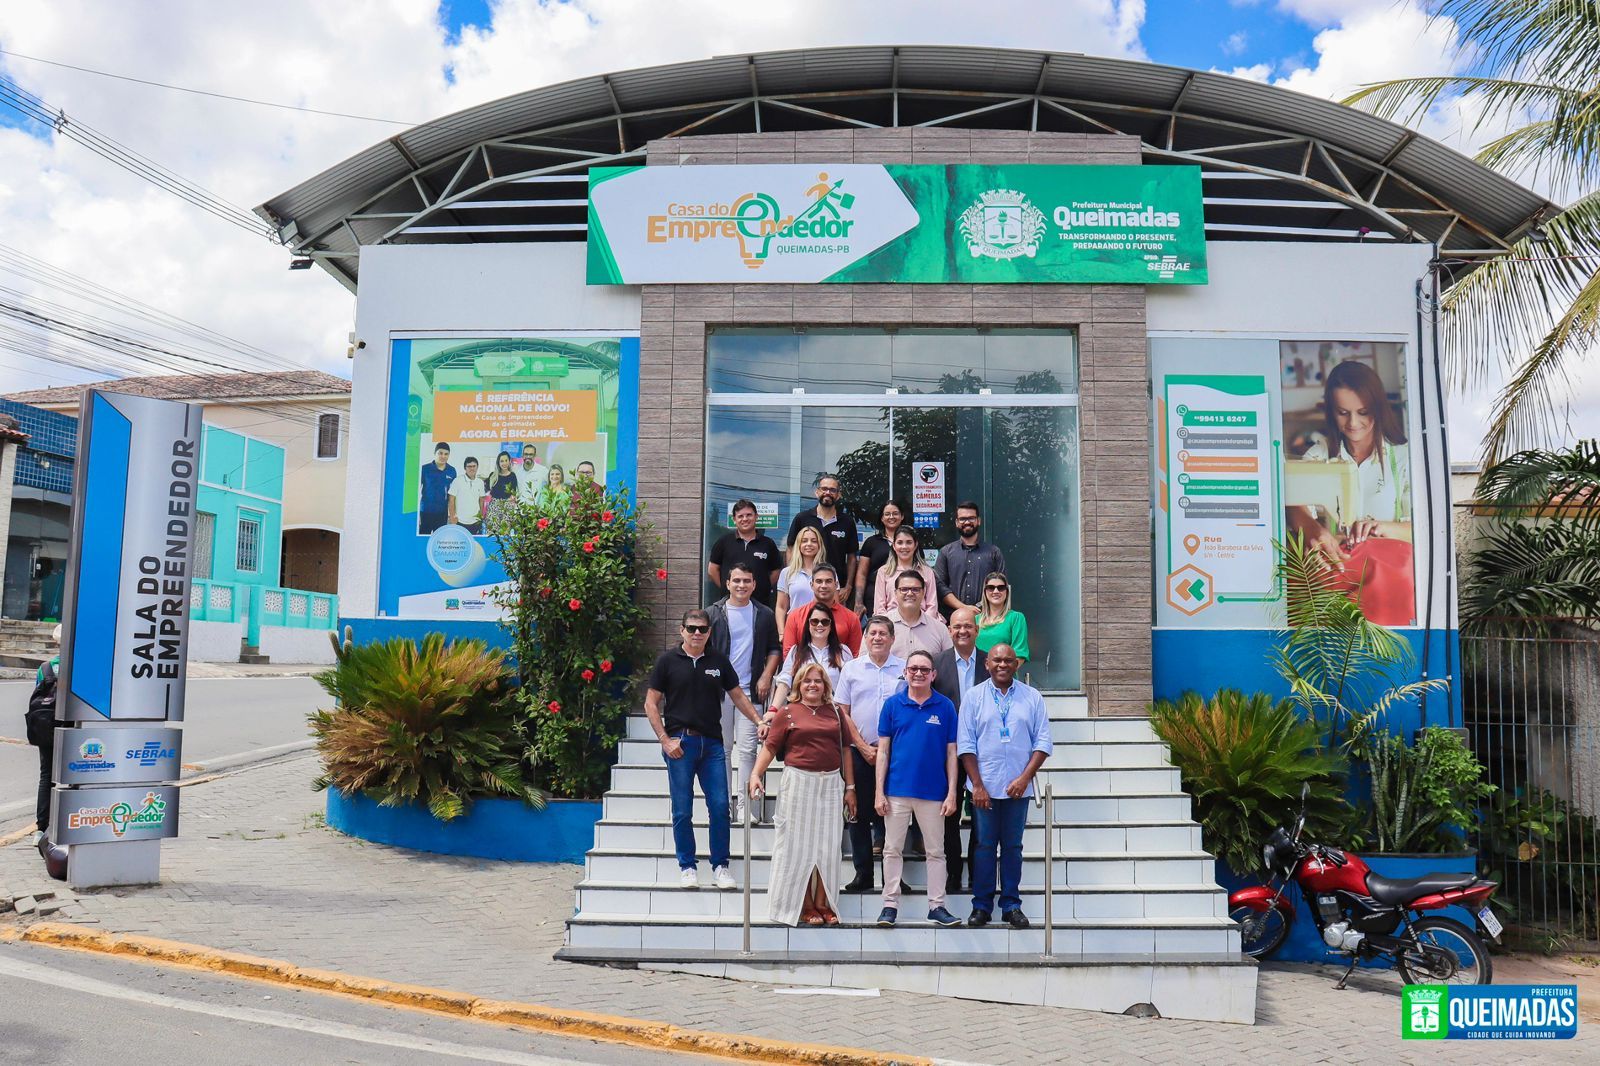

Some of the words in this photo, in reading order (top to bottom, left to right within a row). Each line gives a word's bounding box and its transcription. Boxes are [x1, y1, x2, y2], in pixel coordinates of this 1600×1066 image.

[668, 203, 705, 216] Casa
[708, 202, 730, 216] do
[1053, 206, 1181, 230] Queimadas
[1058, 233, 1127, 241] TRANSFORMANDO
[1128, 233, 1134, 241] O
[1135, 233, 1177, 242] PRESENTE,
[776, 245, 850, 254] QUEIMADAS-PB
[1073, 242, 1125, 250] PREPARANDO
[1125, 242, 1132, 250] O
[1132, 242, 1163, 250] FUTURO
[1147, 262, 1191, 271] SEBRAE
[475, 392, 483, 402] É
[487, 391, 555, 402] REFERÊNCIA
[459, 404, 515, 413] NACIONAL
[517, 404, 532, 412] DE
[535, 403, 570, 412] NOVO!
[459, 430, 498, 439] AGORA
[500, 428, 507, 438] É
[156, 439, 195, 679] EMPREENDEDOR
[137, 555, 161, 596] DO
[131, 603, 158, 679] SALA
[125, 748, 176, 759] SEBRAE
[68, 760, 116, 771] Queimadas
